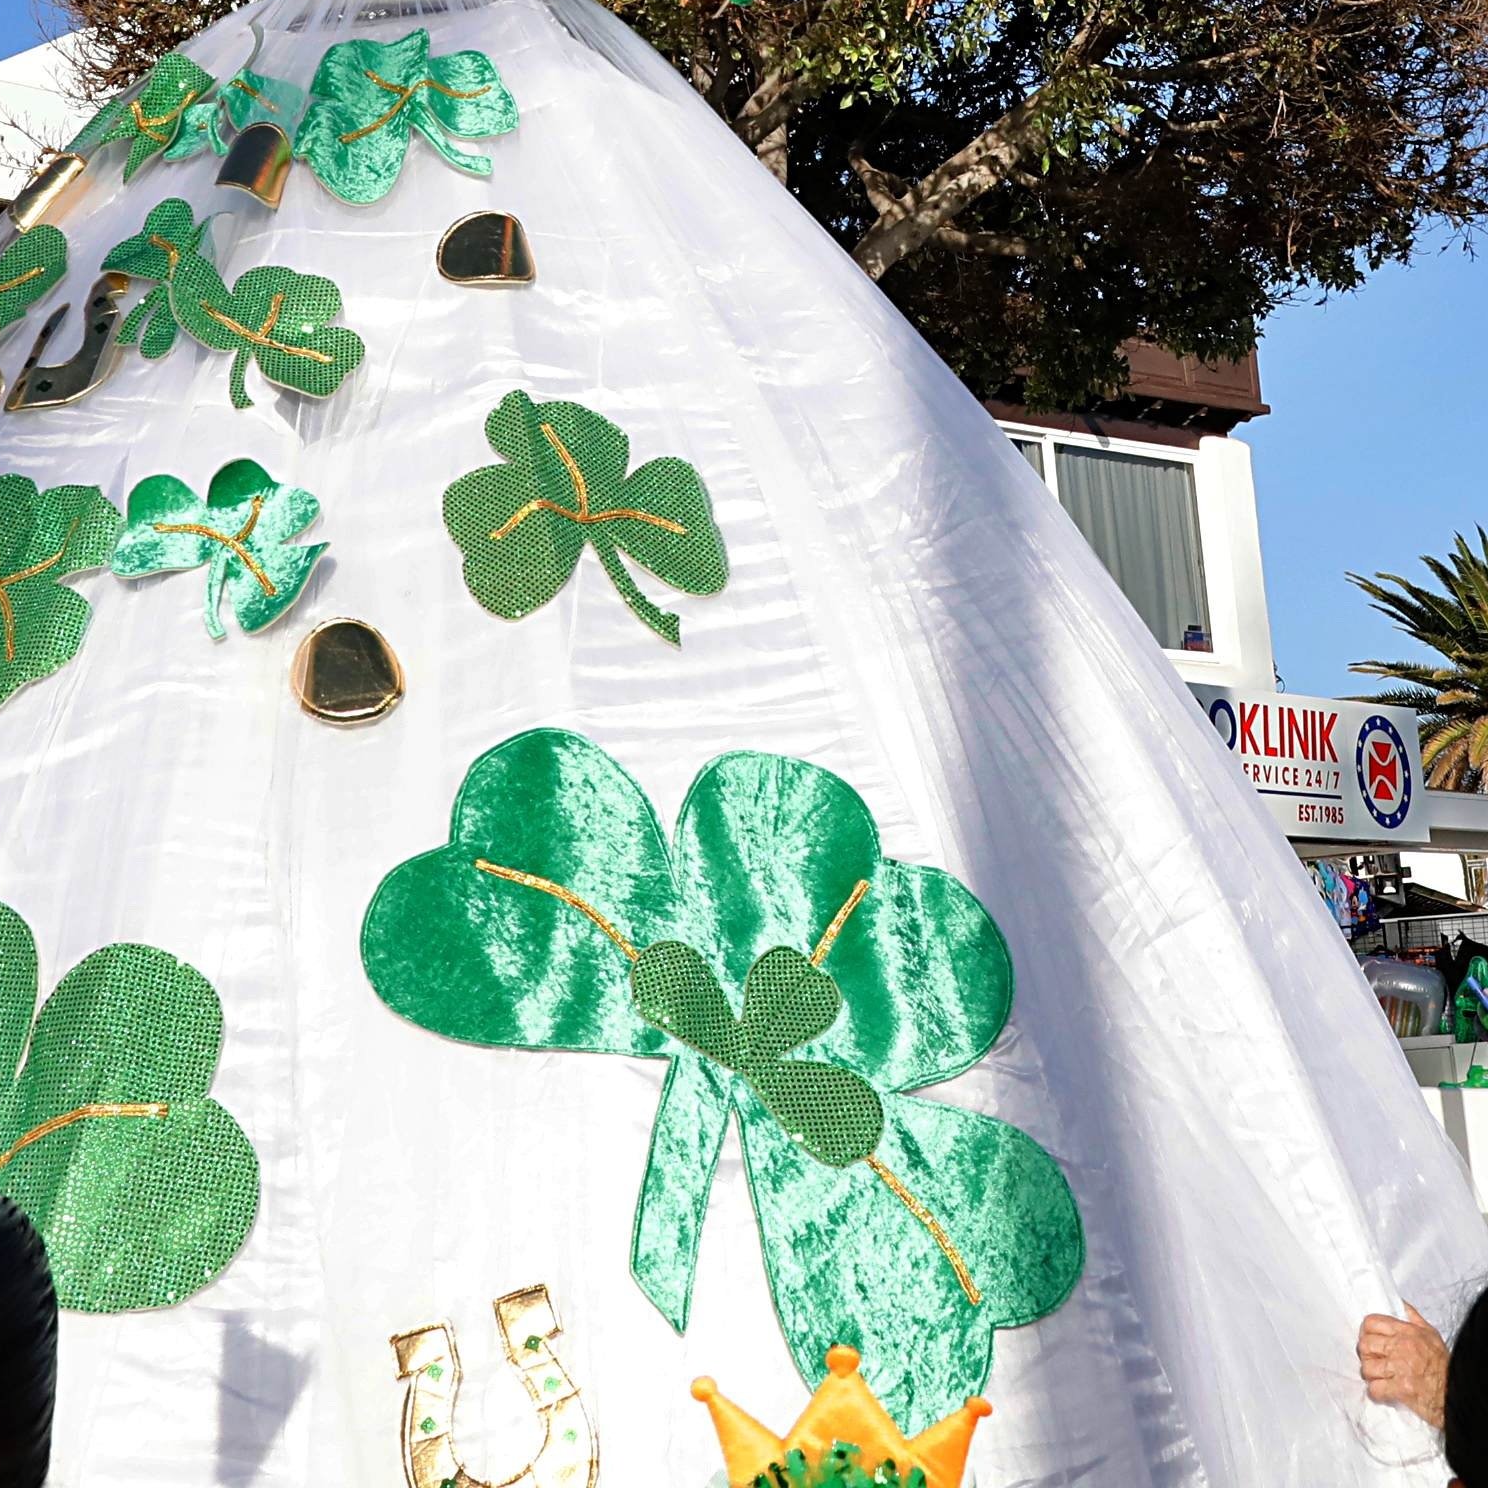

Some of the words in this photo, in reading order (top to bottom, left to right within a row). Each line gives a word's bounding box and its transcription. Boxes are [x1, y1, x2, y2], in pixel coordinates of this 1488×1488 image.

[1197, 699, 1339, 763] OKLINIK
[1305, 769, 1340, 790] 24/7
[1298, 804, 1344, 824] EST.1985
